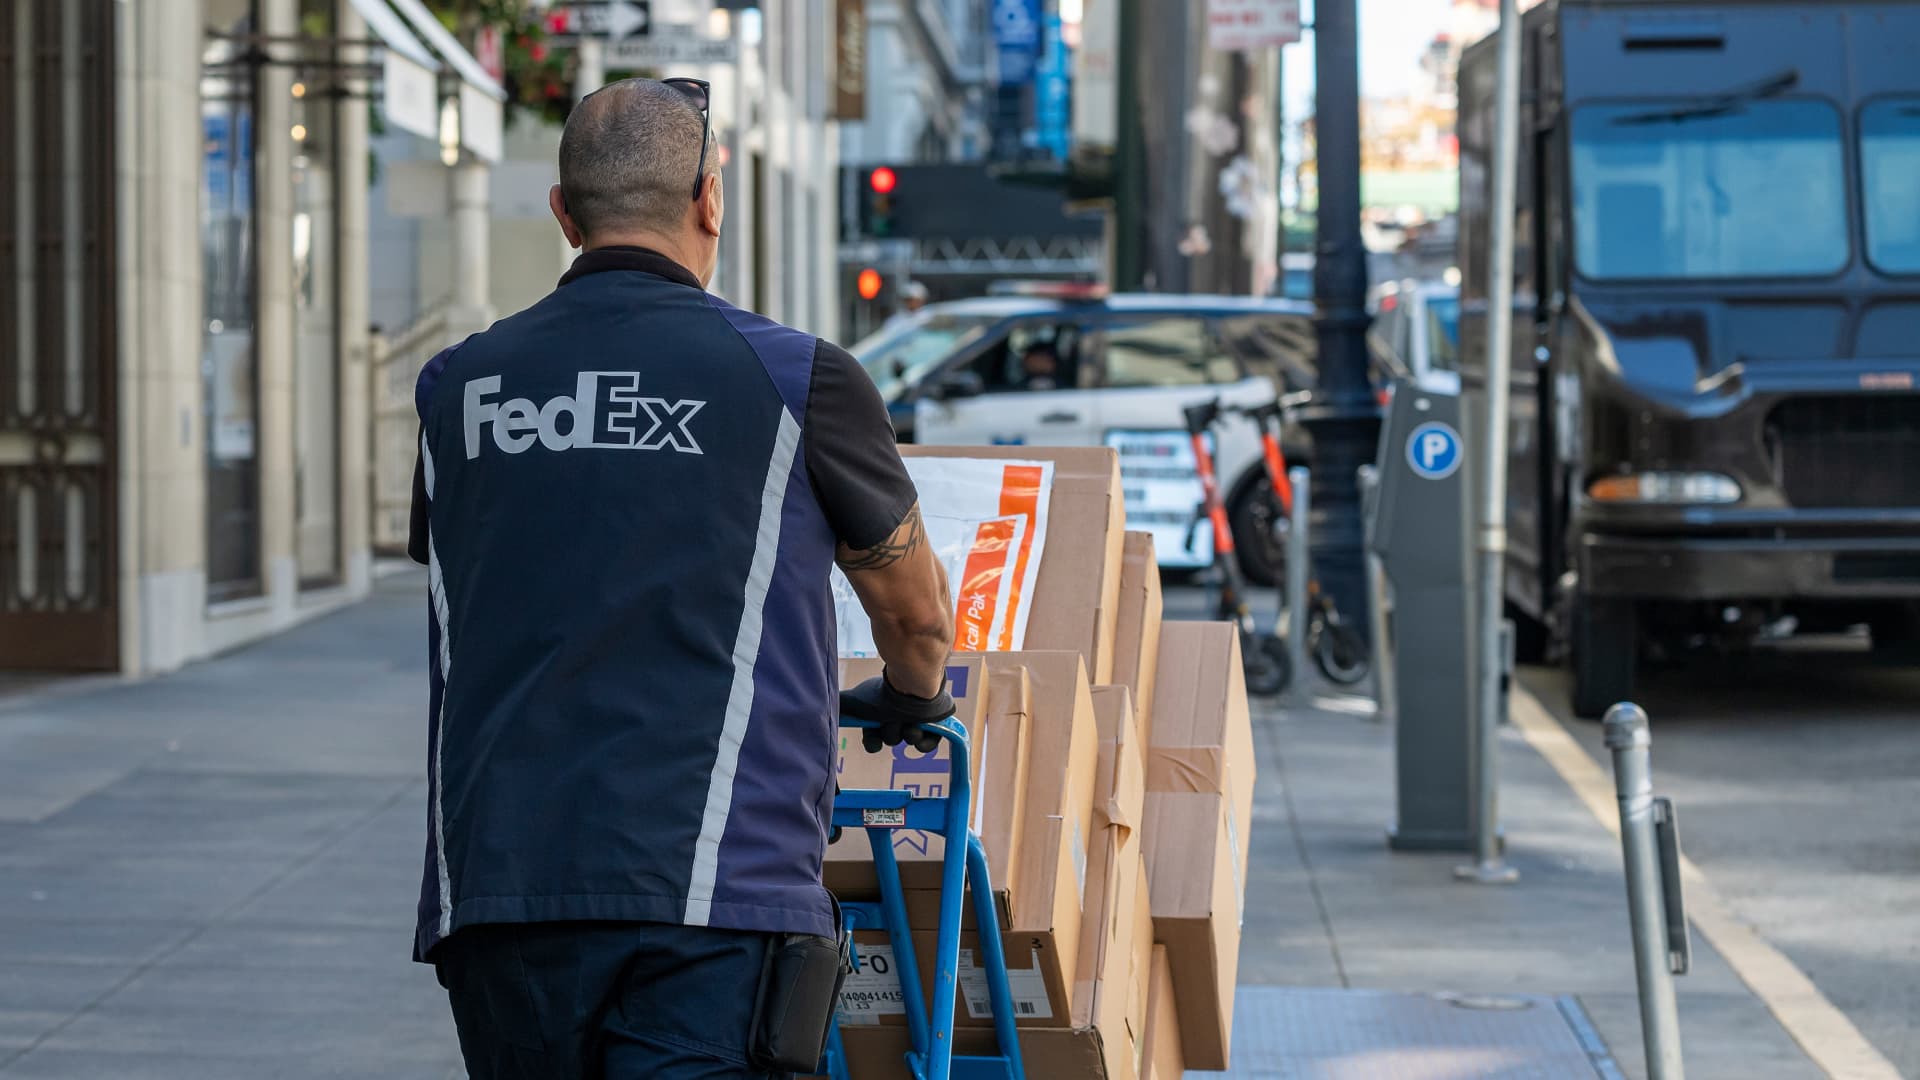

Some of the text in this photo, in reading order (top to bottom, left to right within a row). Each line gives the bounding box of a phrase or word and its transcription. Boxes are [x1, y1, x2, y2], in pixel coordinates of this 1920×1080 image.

[464, 371, 707, 460] FedEx
[1423, 433, 1449, 469] P
[967, 592, 986, 620] Pak
[846, 954, 890, 975] FO
